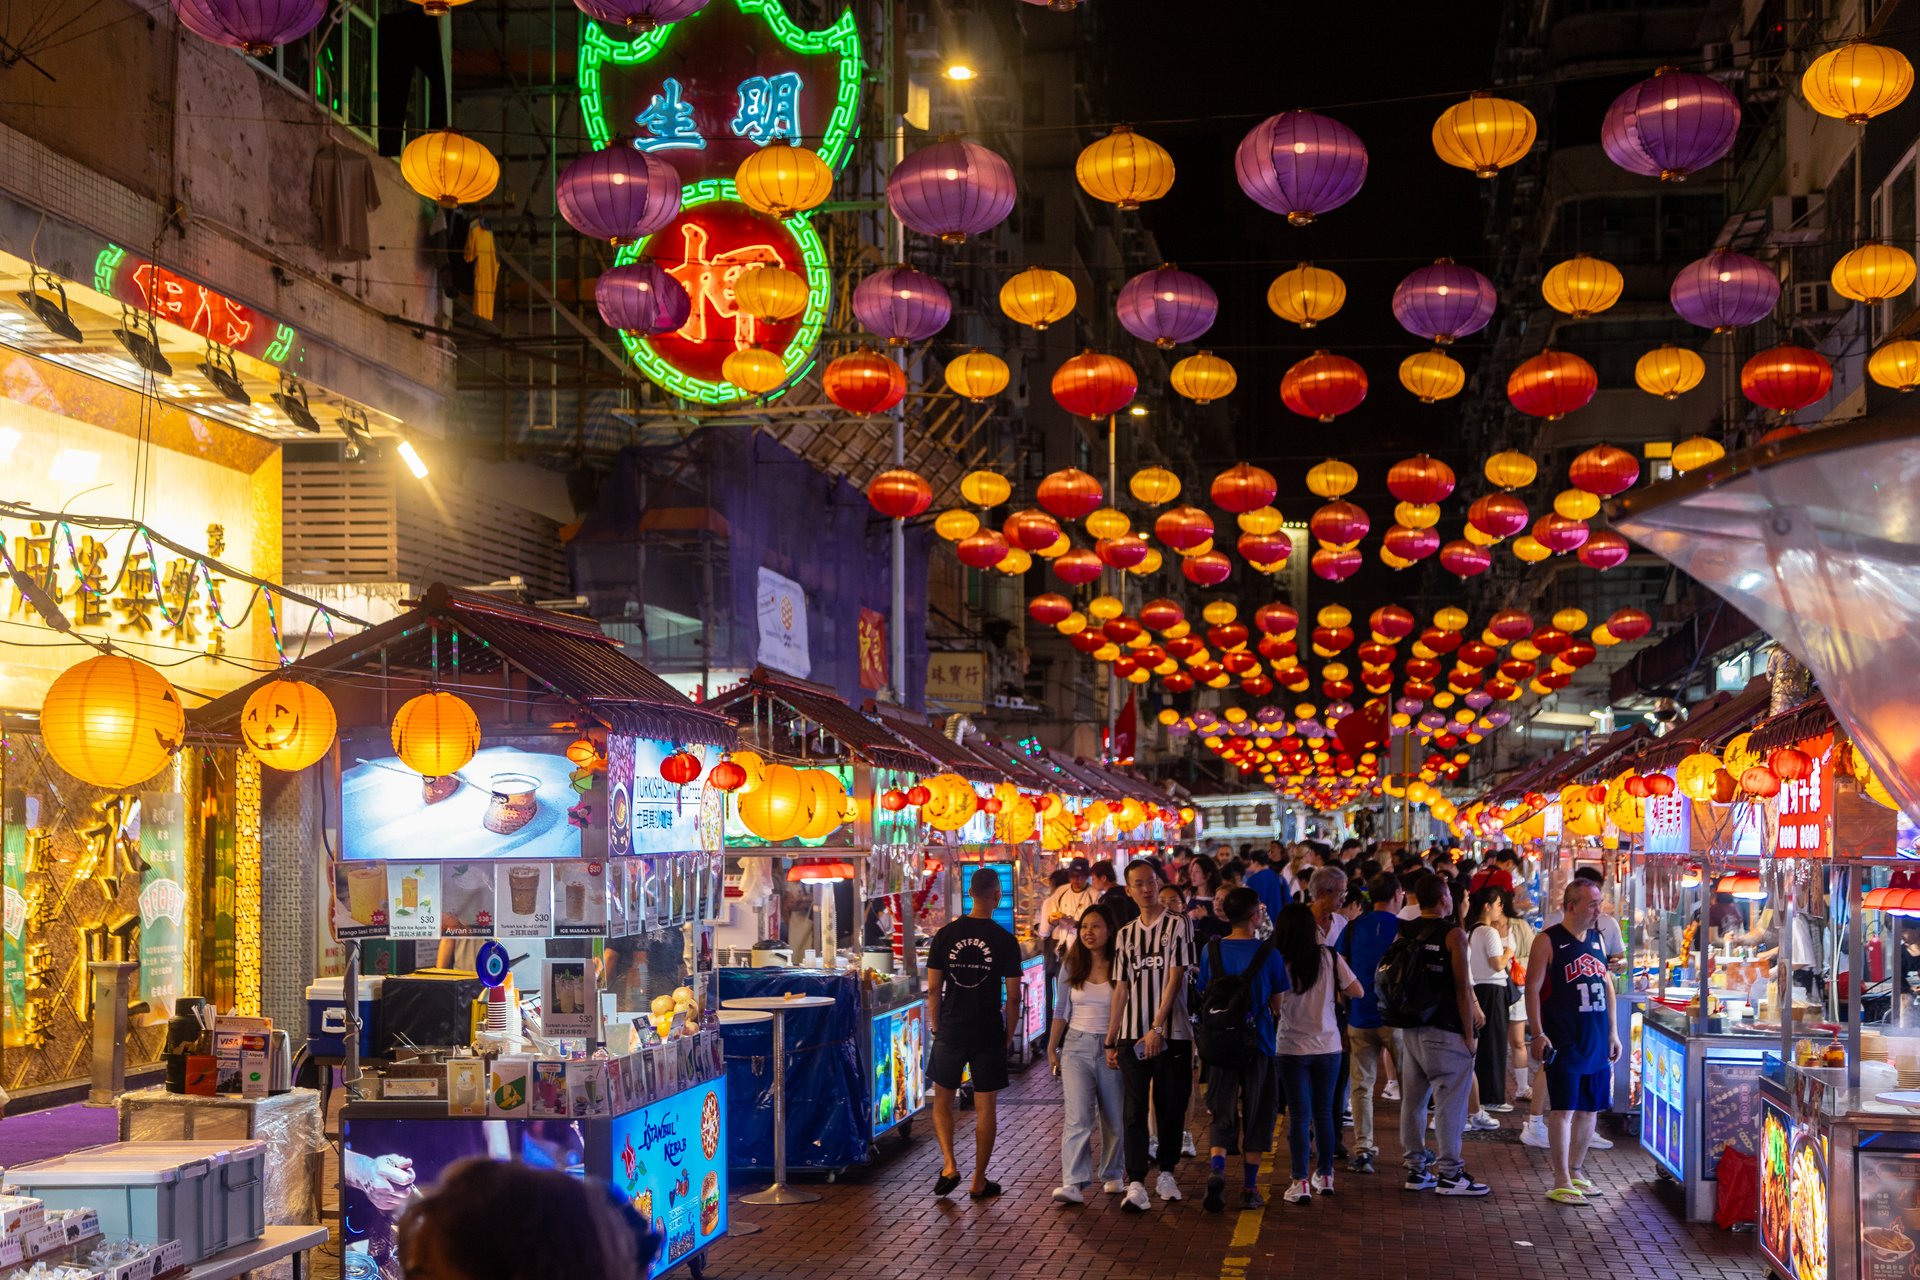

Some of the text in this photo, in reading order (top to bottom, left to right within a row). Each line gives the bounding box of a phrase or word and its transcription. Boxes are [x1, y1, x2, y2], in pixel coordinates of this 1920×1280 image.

[420, 915, 435, 924] $30
[534, 914, 549, 922] $30
[445, 927, 467, 936] Ayran
[949, 938, 991, 960] PLATFORM
[1565, 953, 1608, 984] USA
[1576, 982, 1607, 1012] 13
[579, 1015, 593, 1023] $30
[220, 1038, 239, 1046] VISA
[664, 1138, 687, 1166] KEBAB
